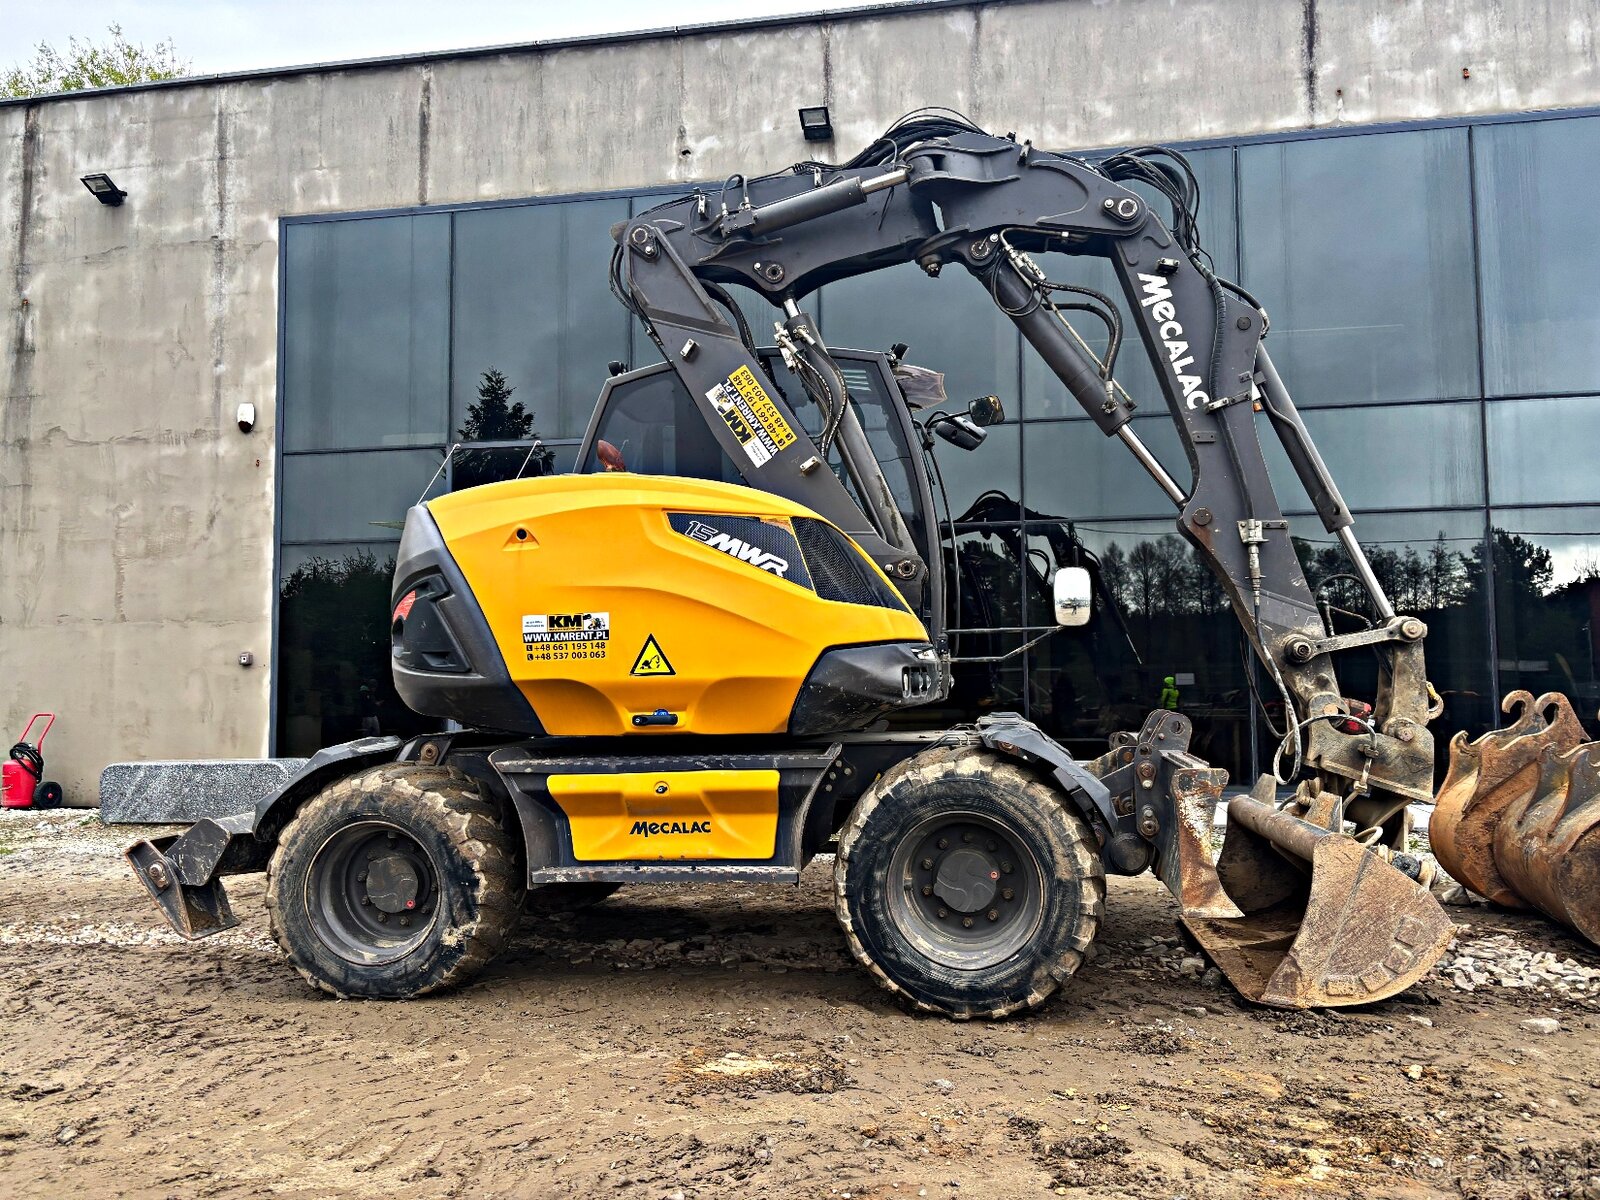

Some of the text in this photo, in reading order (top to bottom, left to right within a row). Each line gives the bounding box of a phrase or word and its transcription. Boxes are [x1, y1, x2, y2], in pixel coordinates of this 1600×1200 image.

[733, 375, 780, 439] +48 661 195 148
[740, 369, 788, 433] +48 537 003 063
[723, 378, 779, 456] WWW.KMRENT.PL
[723, 408, 752, 443] KM
[548, 615, 582, 628] KM
[523, 631, 608, 643] WWW.KMRENT.PL
[553, 643, 568, 651] 661
[553, 652, 568, 660] 537
